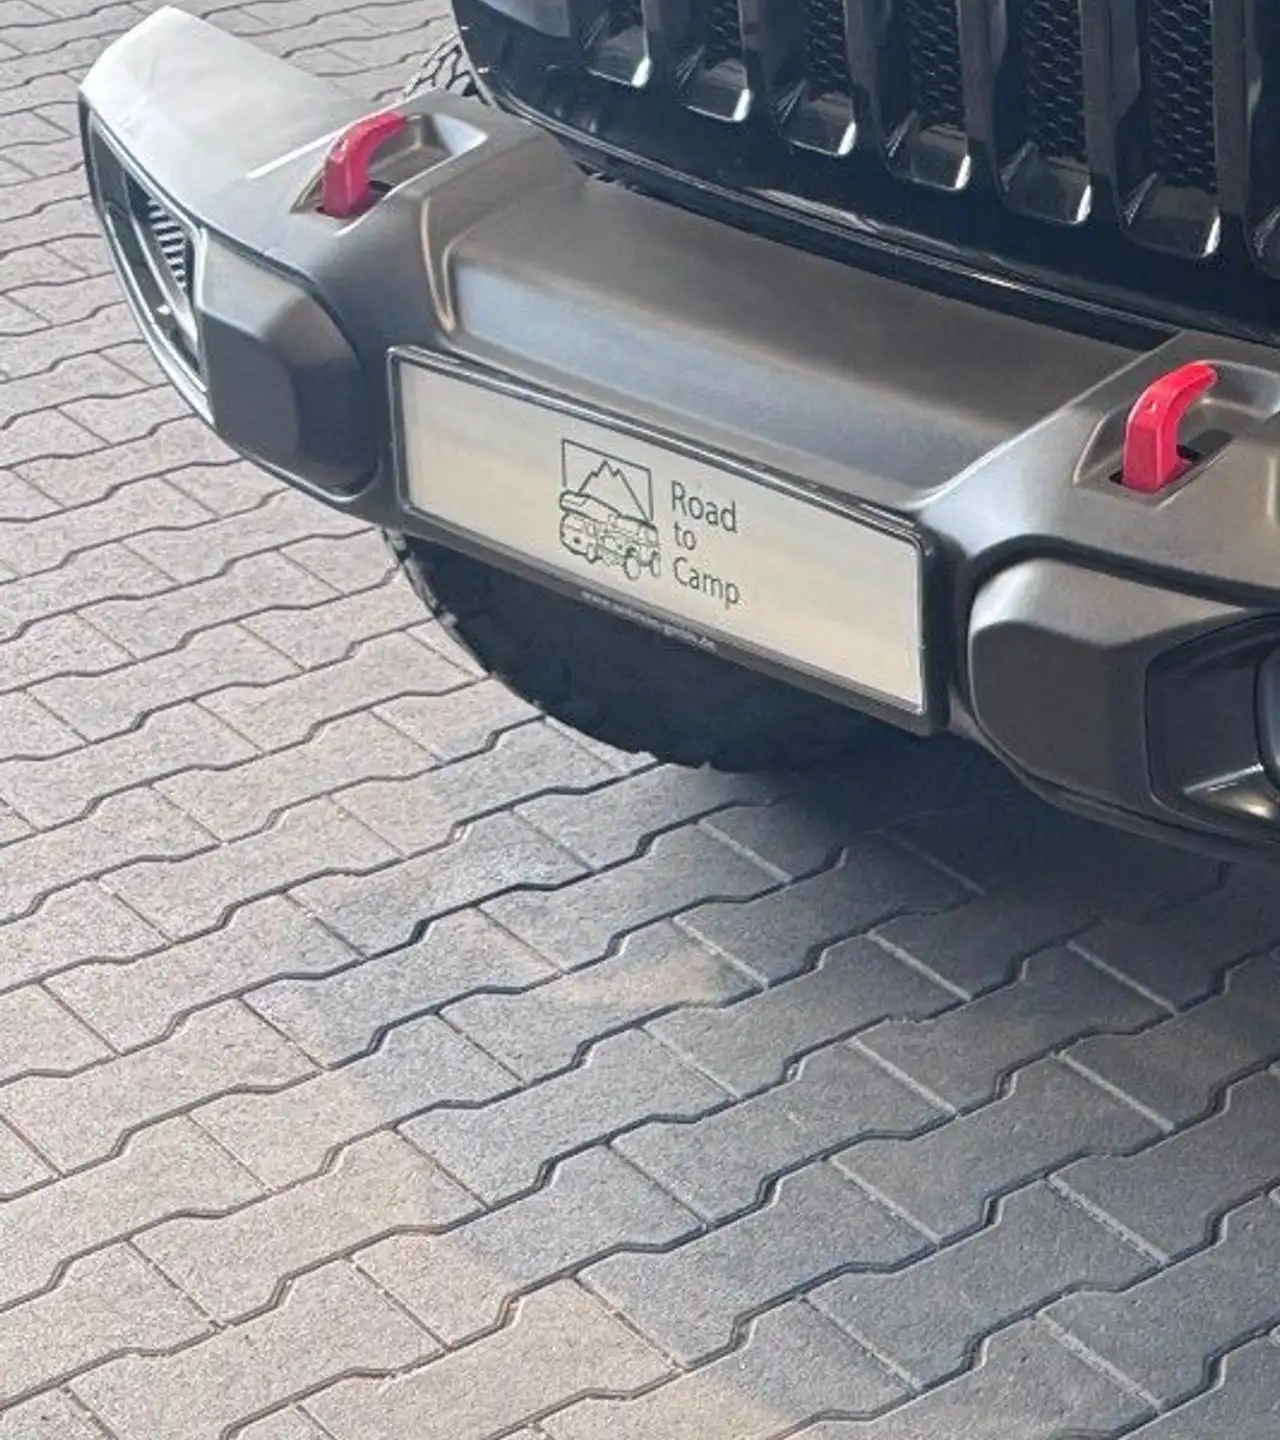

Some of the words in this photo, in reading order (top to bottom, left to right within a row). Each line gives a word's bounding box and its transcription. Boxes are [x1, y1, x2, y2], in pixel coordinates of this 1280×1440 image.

[671, 479, 738, 533] Road
[674, 520, 697, 551] to
[672, 556, 741, 611] Camp
